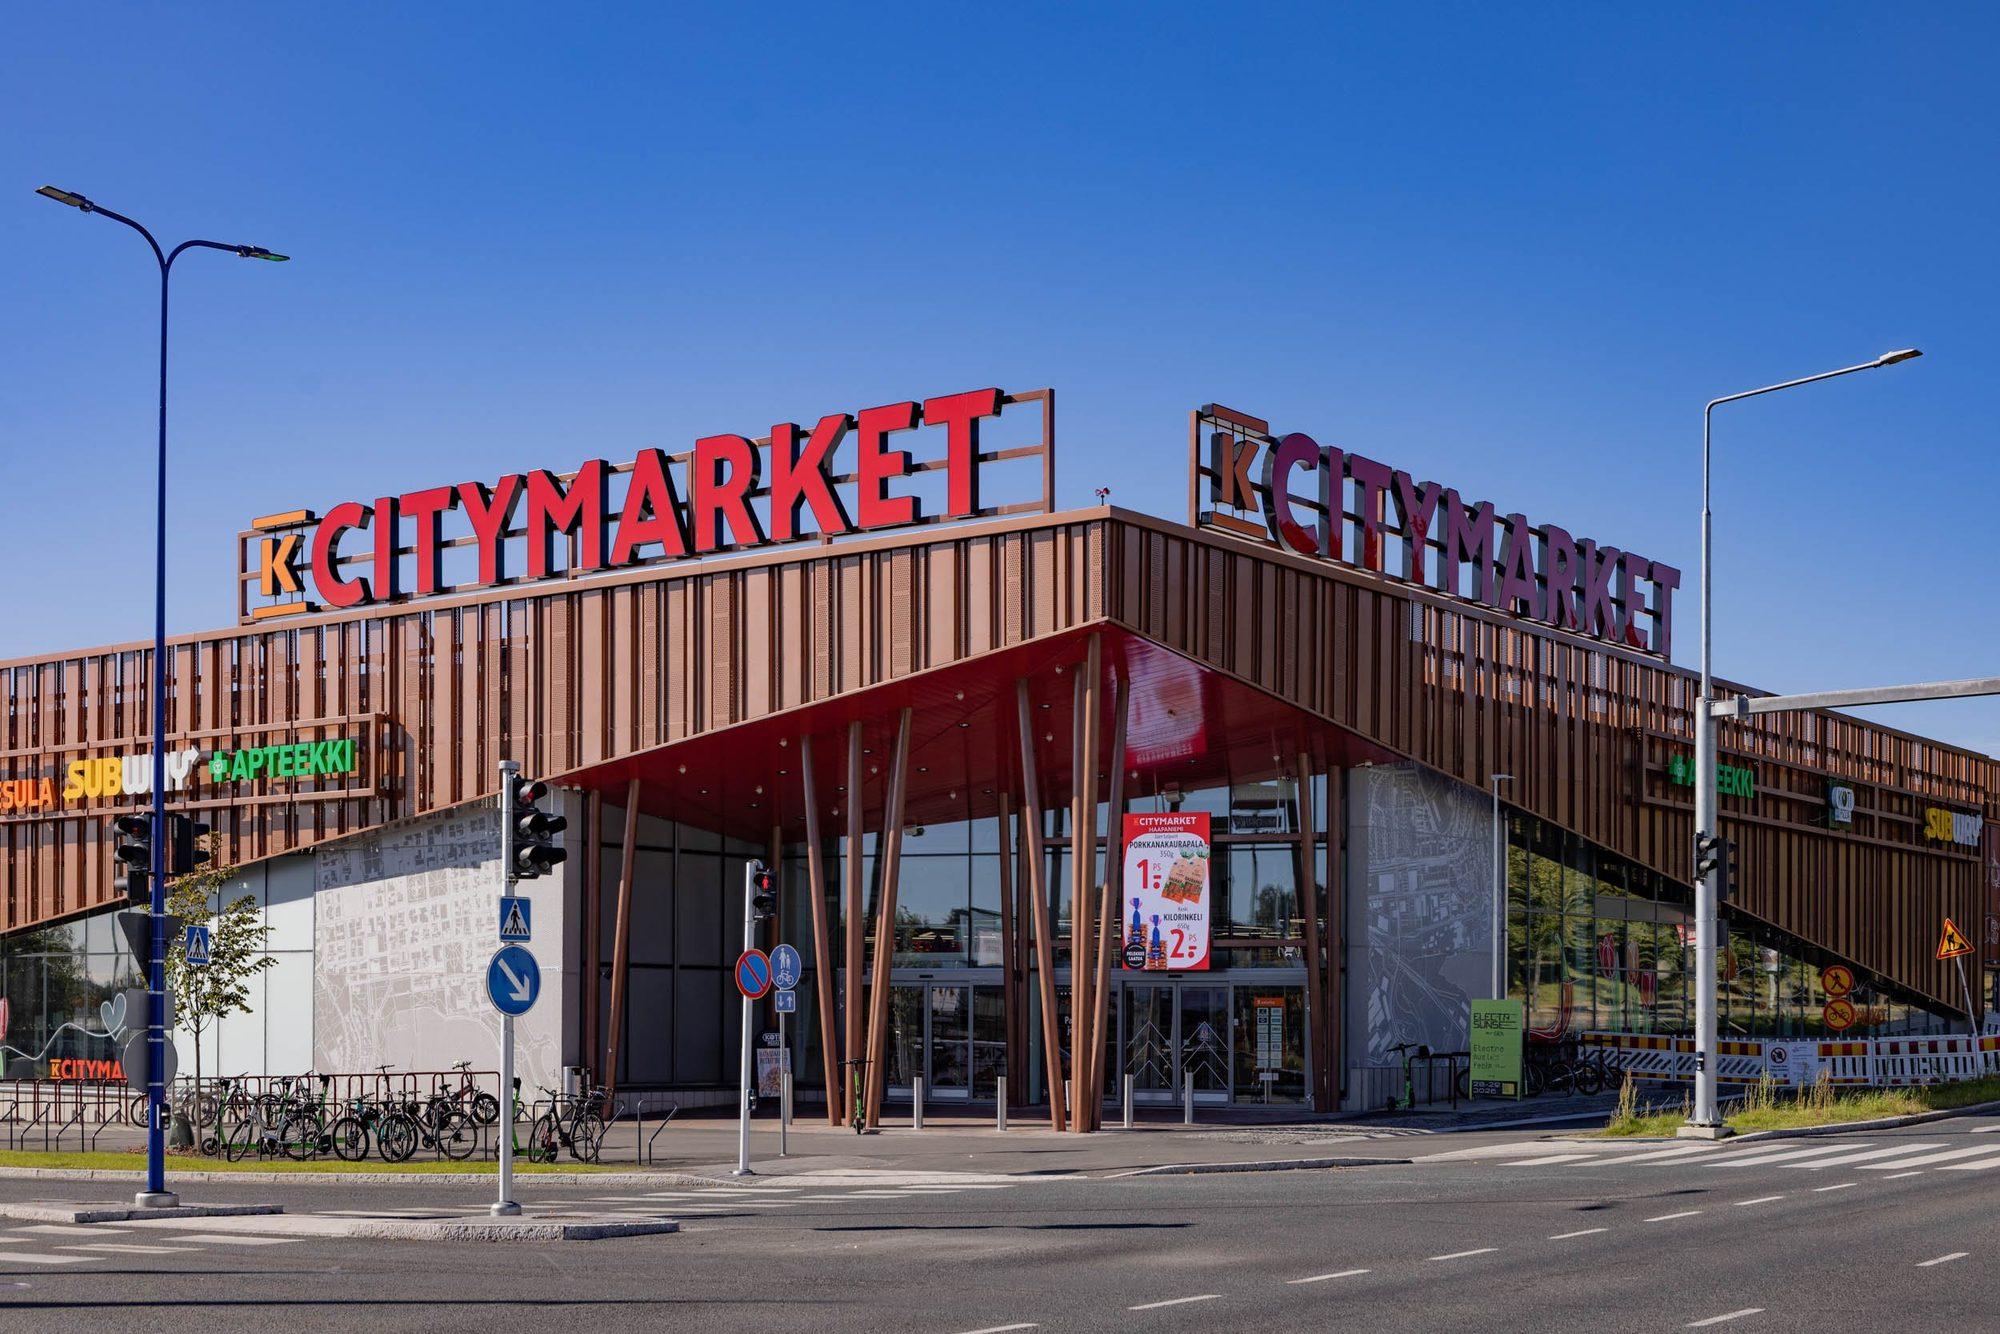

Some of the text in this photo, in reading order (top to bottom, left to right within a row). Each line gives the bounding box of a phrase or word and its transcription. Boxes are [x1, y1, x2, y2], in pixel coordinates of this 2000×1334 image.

[311, 388, 1005, 608] CITYMARKET
[1263, 433, 1681, 658] CITYMARKET
[231, 738, 356, 781] APTEEKKI
[1686, 758, 1754, 799] AEEKKI
[1139, 817, 1197, 826] CITYMARKET
[1924, 807, 1983, 847] SUBWAY
[1129, 841, 1204, 849] PORKKANAKAURAPALA
[1163, 913, 1203, 921] KILORINKELI
[61, 1060, 127, 1079] CITYMA
